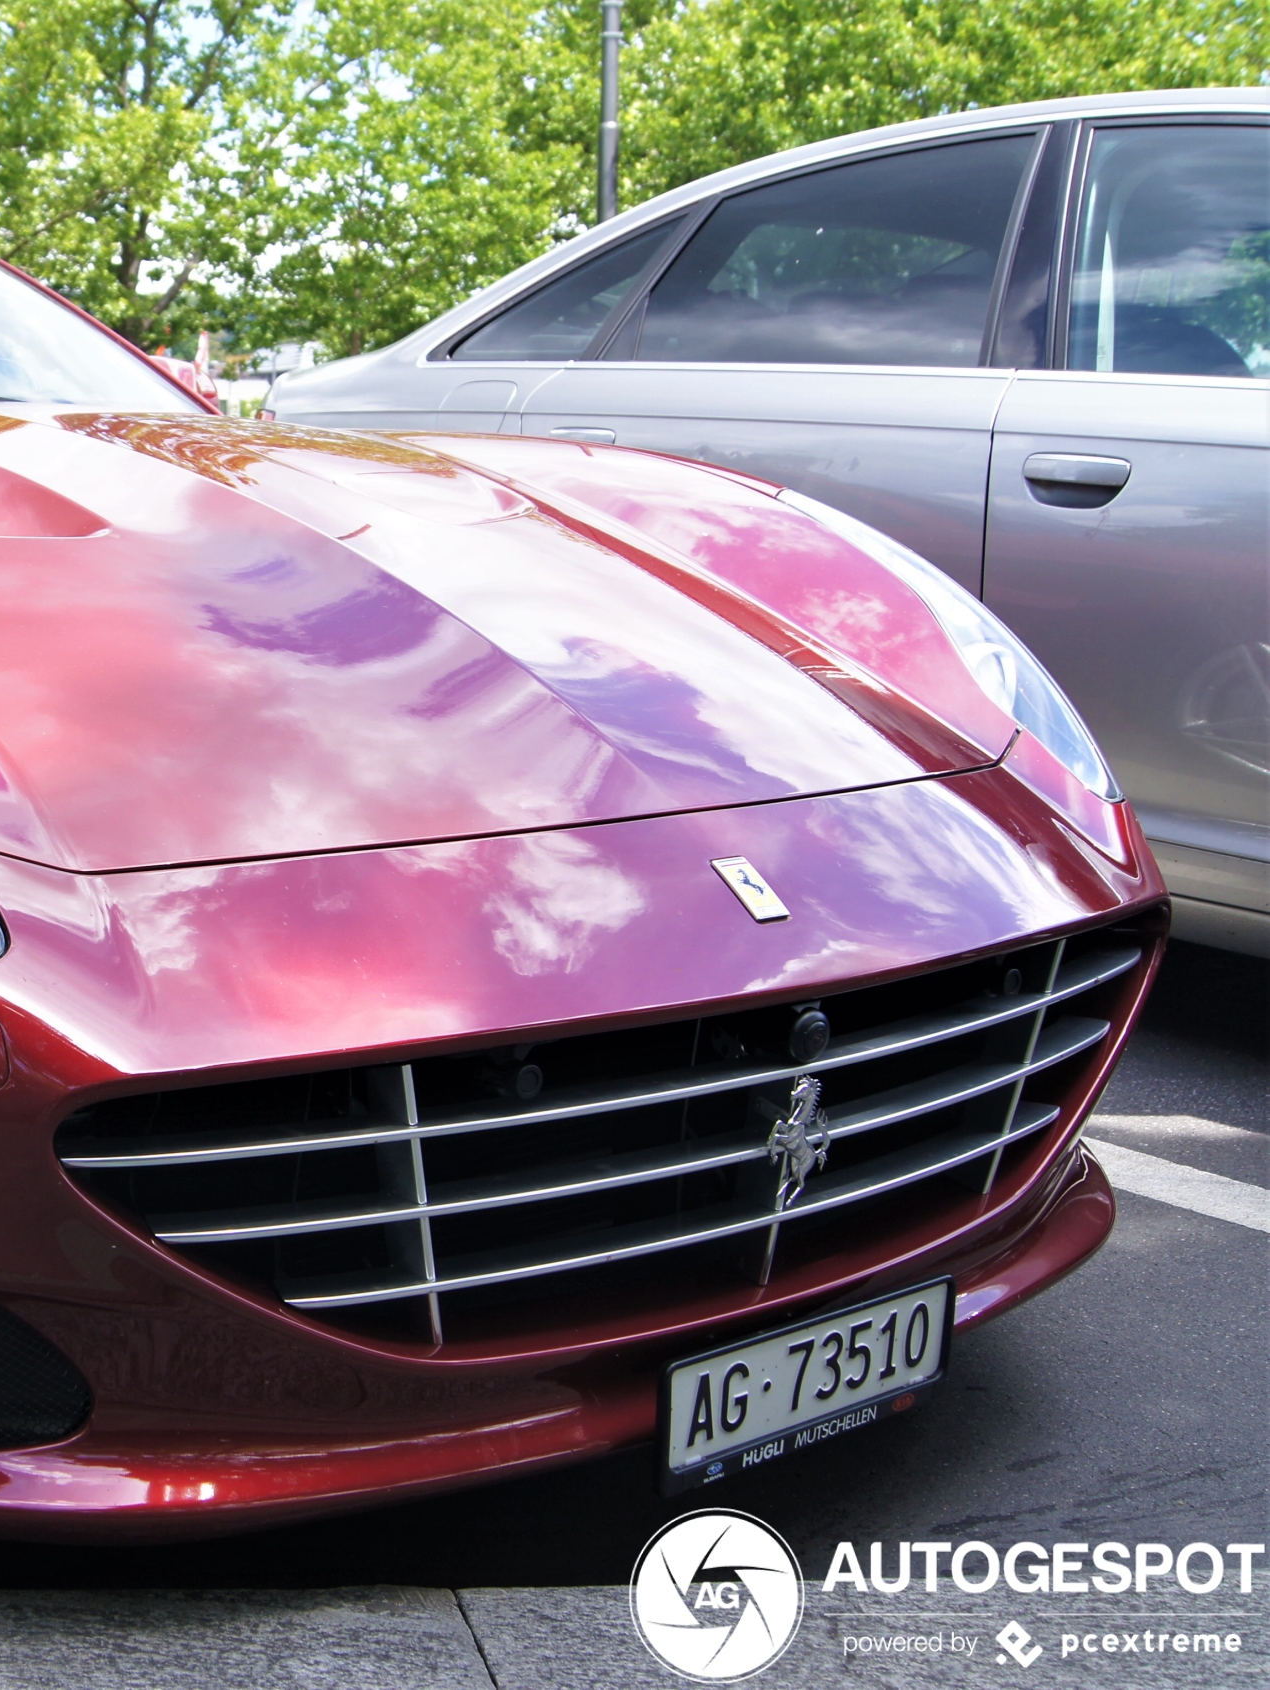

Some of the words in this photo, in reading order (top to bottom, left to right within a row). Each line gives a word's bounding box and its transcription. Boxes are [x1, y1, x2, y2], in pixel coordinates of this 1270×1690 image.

[788, 1301, 930, 1413] 73510
[742, 1439, 785, 1468] HÜGLI
[794, 1405, 878, 1449] MUTSCHELLEN
